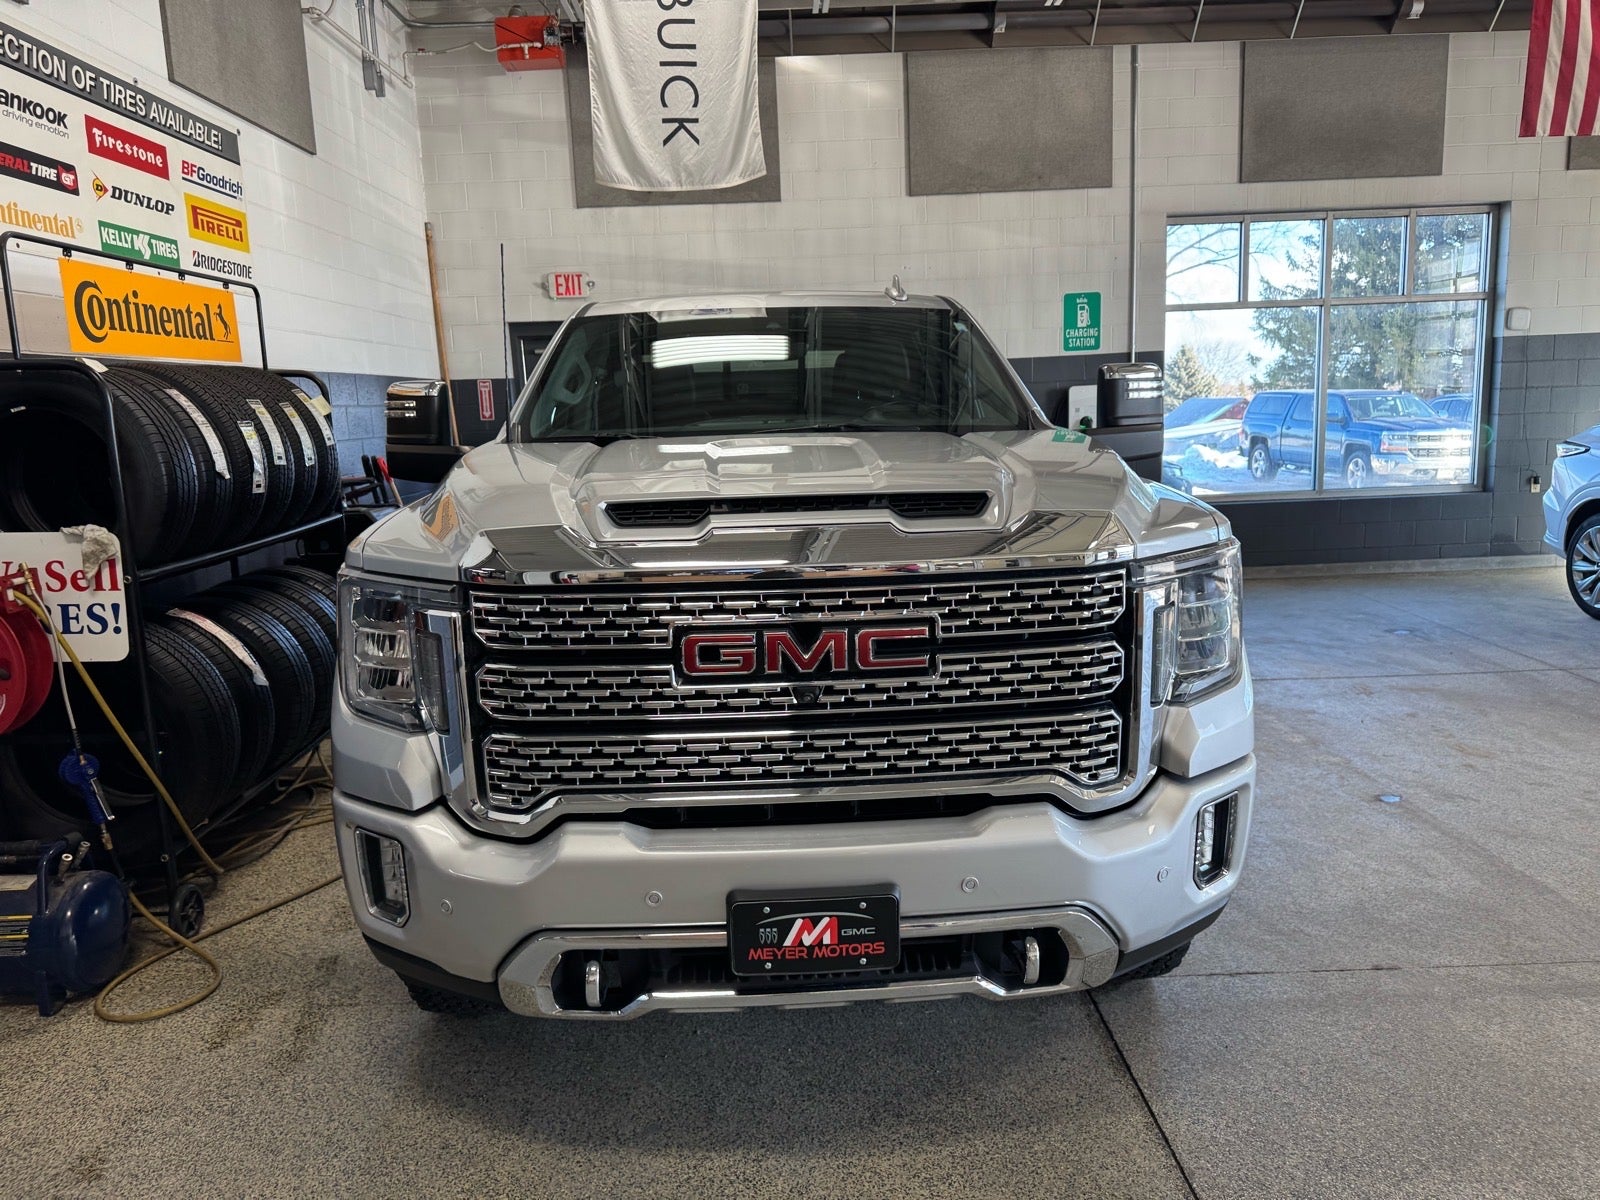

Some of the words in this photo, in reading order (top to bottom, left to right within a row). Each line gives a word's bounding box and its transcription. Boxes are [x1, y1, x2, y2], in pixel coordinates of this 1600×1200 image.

[71, 65, 96, 93] OF
[100, 77, 146, 117] TIRES
[150, 102, 223, 150] AVAILABLE!
[2, 108, 33, 127] driving
[35, 120, 69, 139] emotion
[92, 127, 164, 168] Firestone
[181, 159, 243, 197] BFGoodrich
[110, 185, 175, 216] DUNLOP
[191, 204, 243, 242] PIRELLI
[101, 226, 132, 249] KELLY
[151, 238, 178, 259] TIRES
[193, 250, 252, 280] BRIDGESTONE
[555, 273, 583, 297] EXIT
[74, 280, 216, 343] Continental
[1065, 328, 1099, 338] CHARGING
[1068, 337, 1095, 347] STATION
[681, 626, 930, 677] GMC
[841, 927, 876, 937] GMC
[748, 947, 808, 961] MEYER
[813, 941, 886, 958] MOTORS
